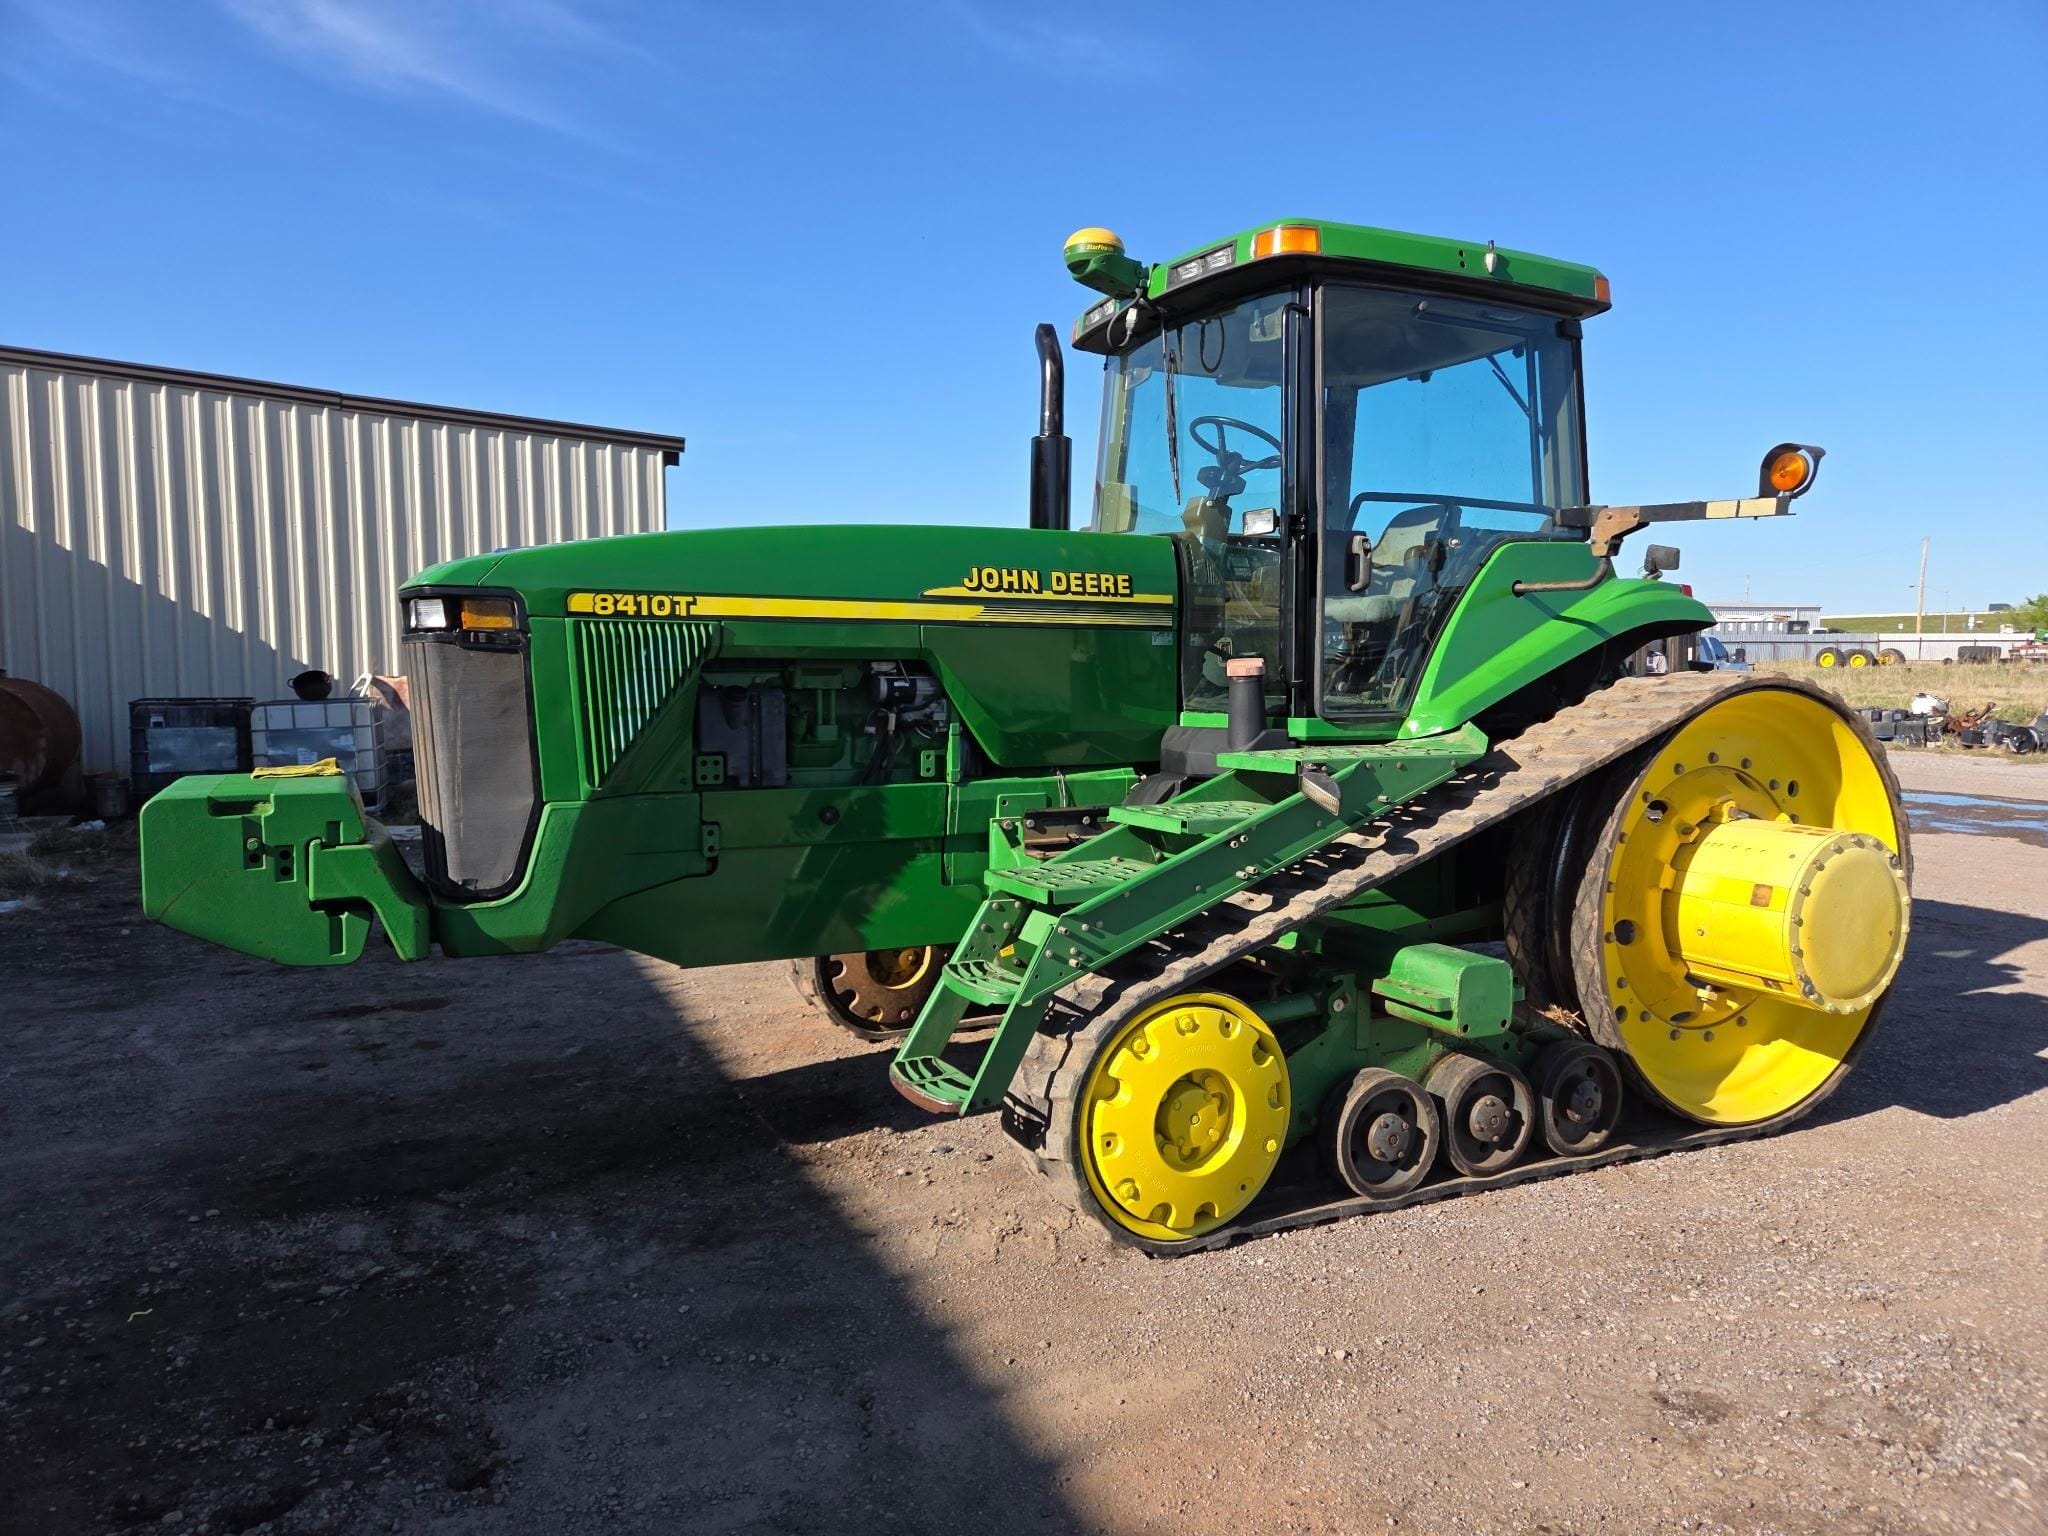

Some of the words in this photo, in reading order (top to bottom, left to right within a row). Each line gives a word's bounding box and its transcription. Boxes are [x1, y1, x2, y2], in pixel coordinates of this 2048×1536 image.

[963, 566, 1042, 593] JOHN
[1050, 571, 1133, 597] DEERE
[593, 593, 693, 616] 8410T
